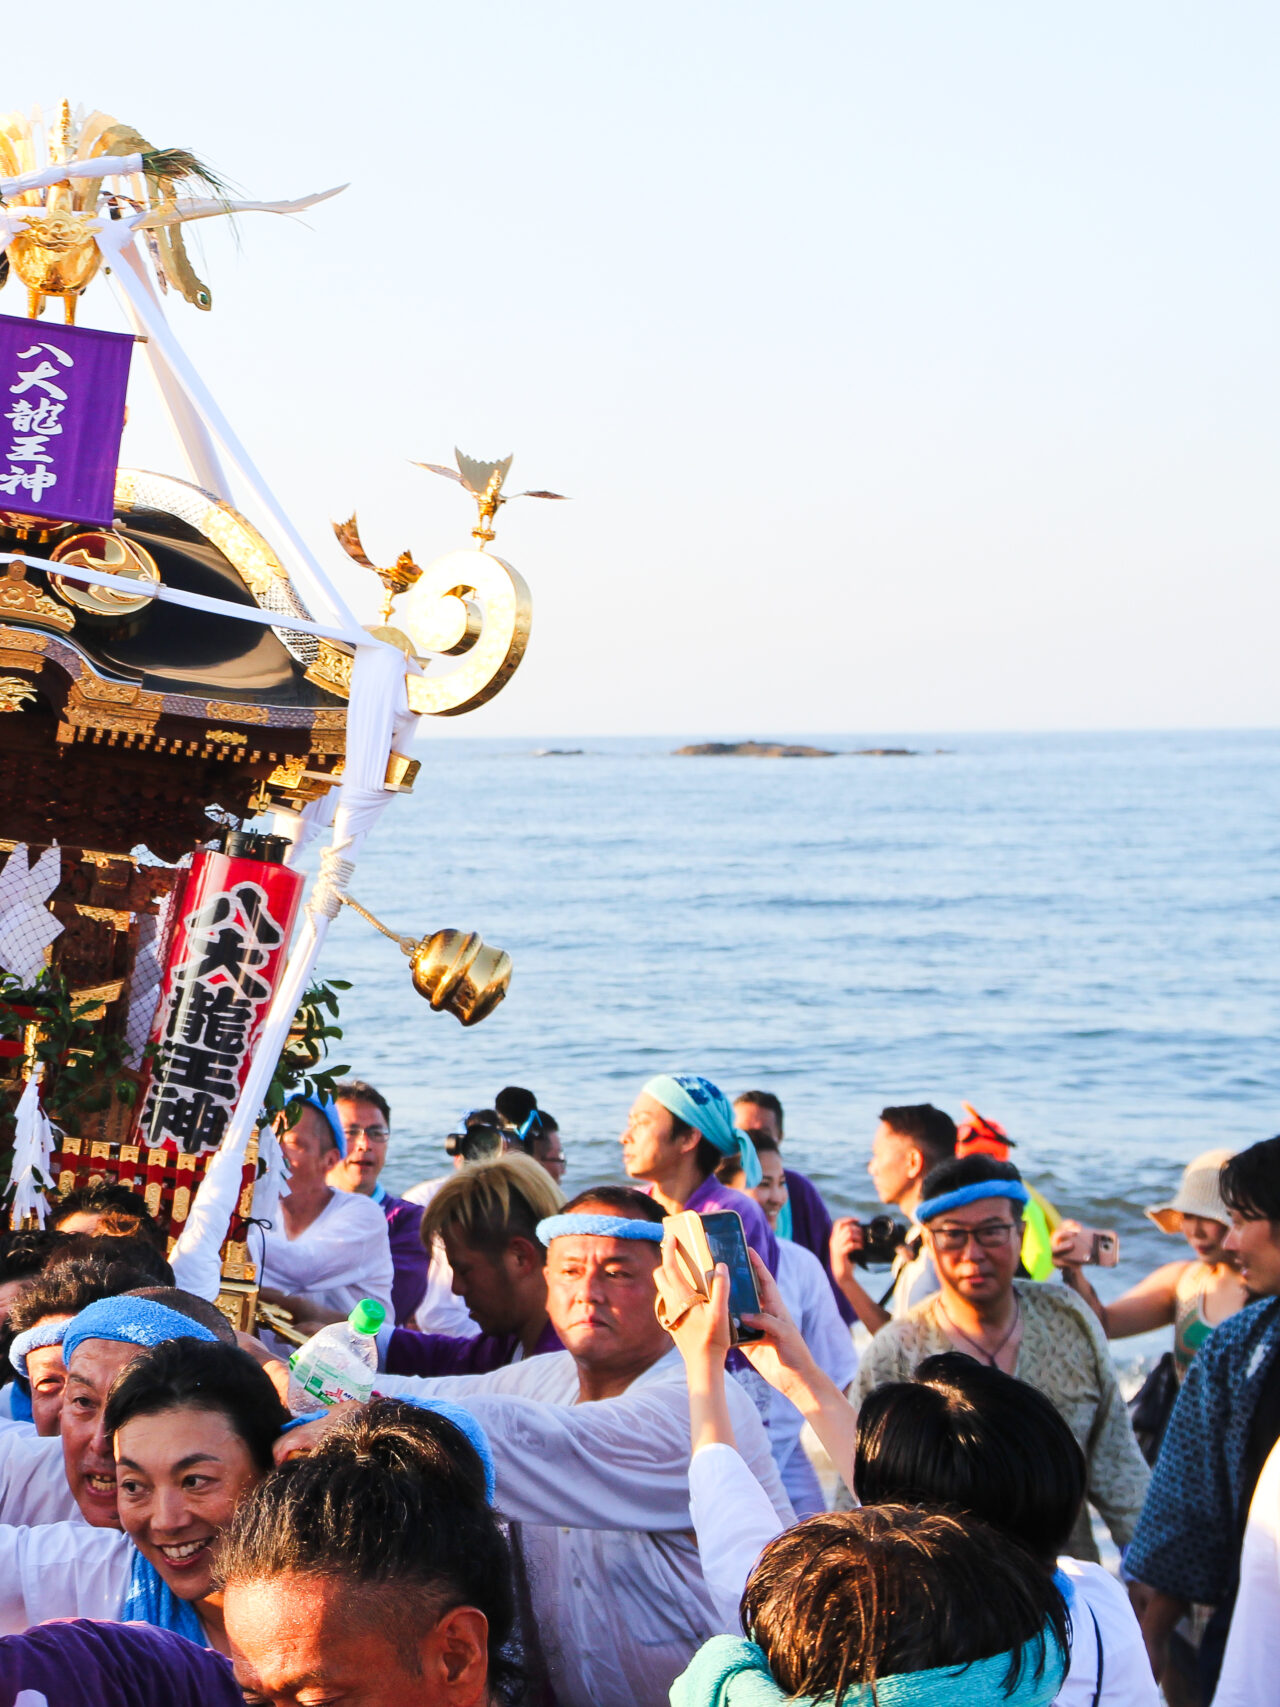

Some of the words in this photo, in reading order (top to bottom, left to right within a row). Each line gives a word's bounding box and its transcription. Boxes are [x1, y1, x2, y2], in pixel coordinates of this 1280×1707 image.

[140, 880, 285, 1157] 八大龍王神
